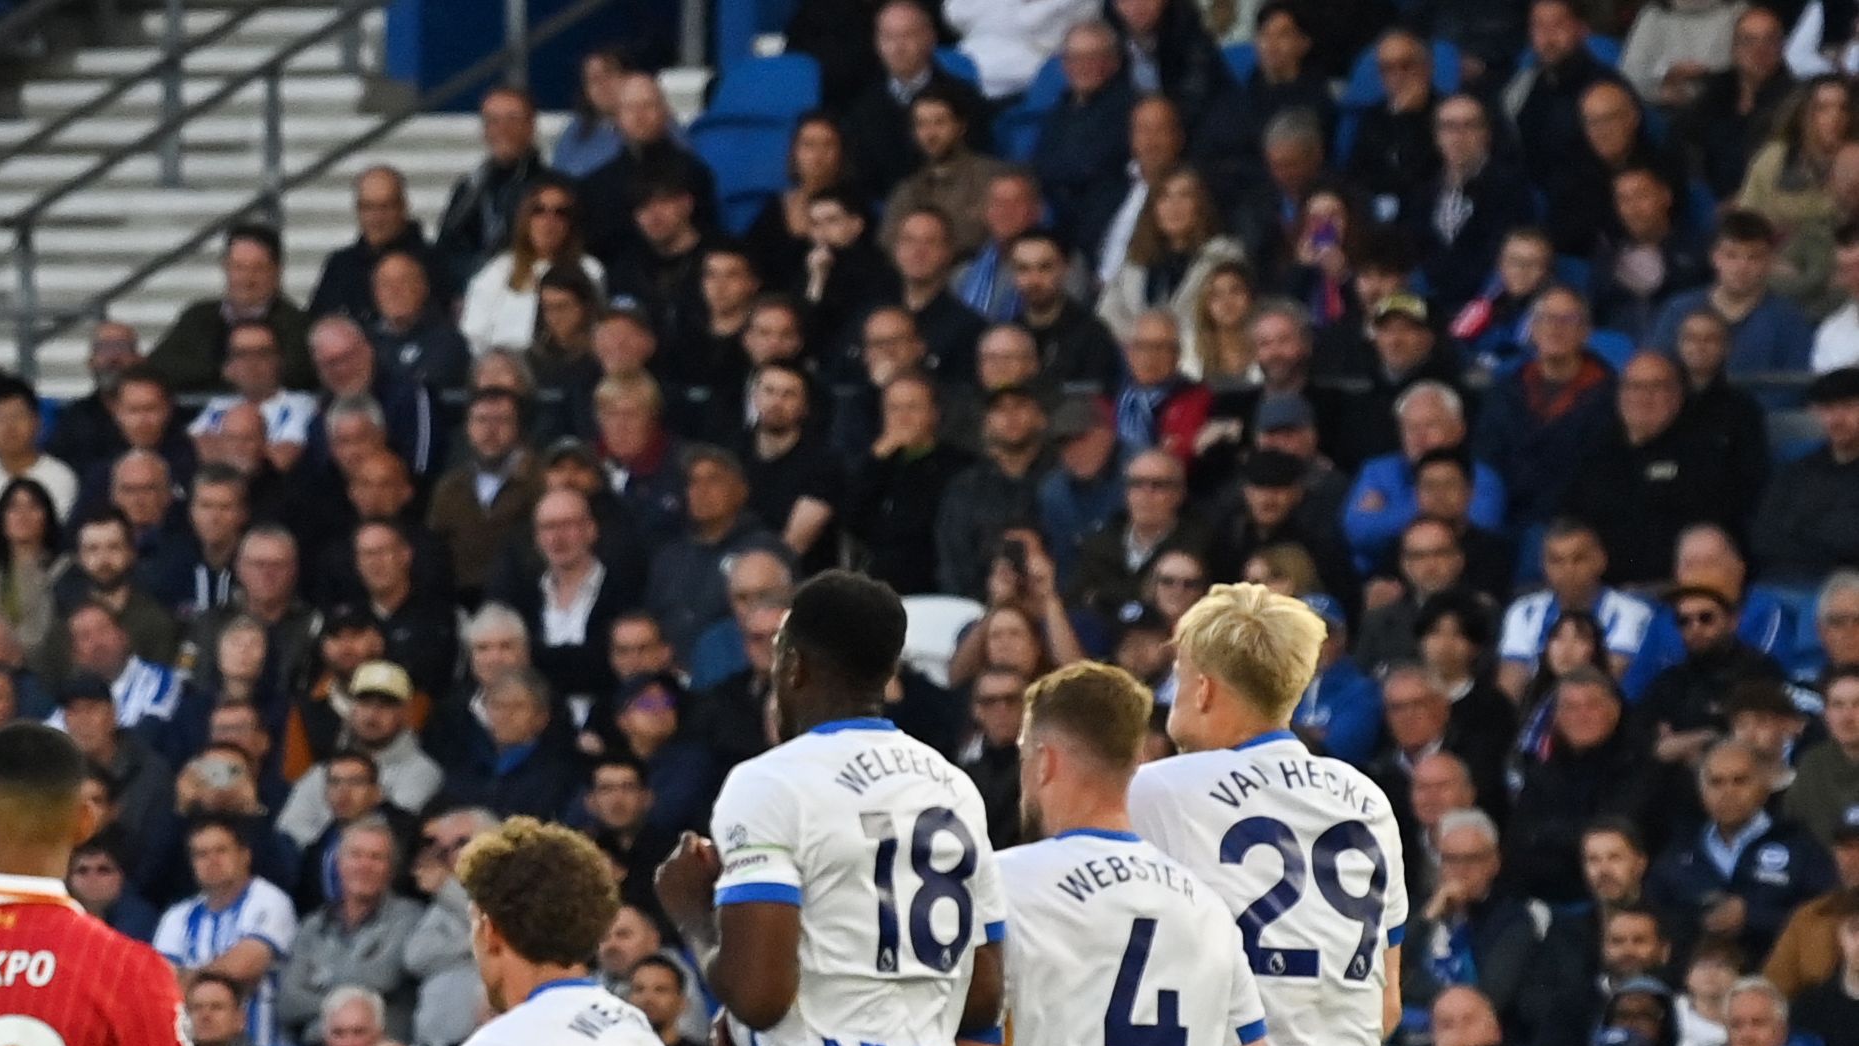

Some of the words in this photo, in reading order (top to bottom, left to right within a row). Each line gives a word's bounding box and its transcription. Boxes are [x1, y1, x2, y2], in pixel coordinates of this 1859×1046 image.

[1279, 759, 1379, 816] HECKE
[858, 806, 978, 974] 18
[1057, 855, 1196, 906] WEBSTER
[1219, 815, 1389, 982] 29
